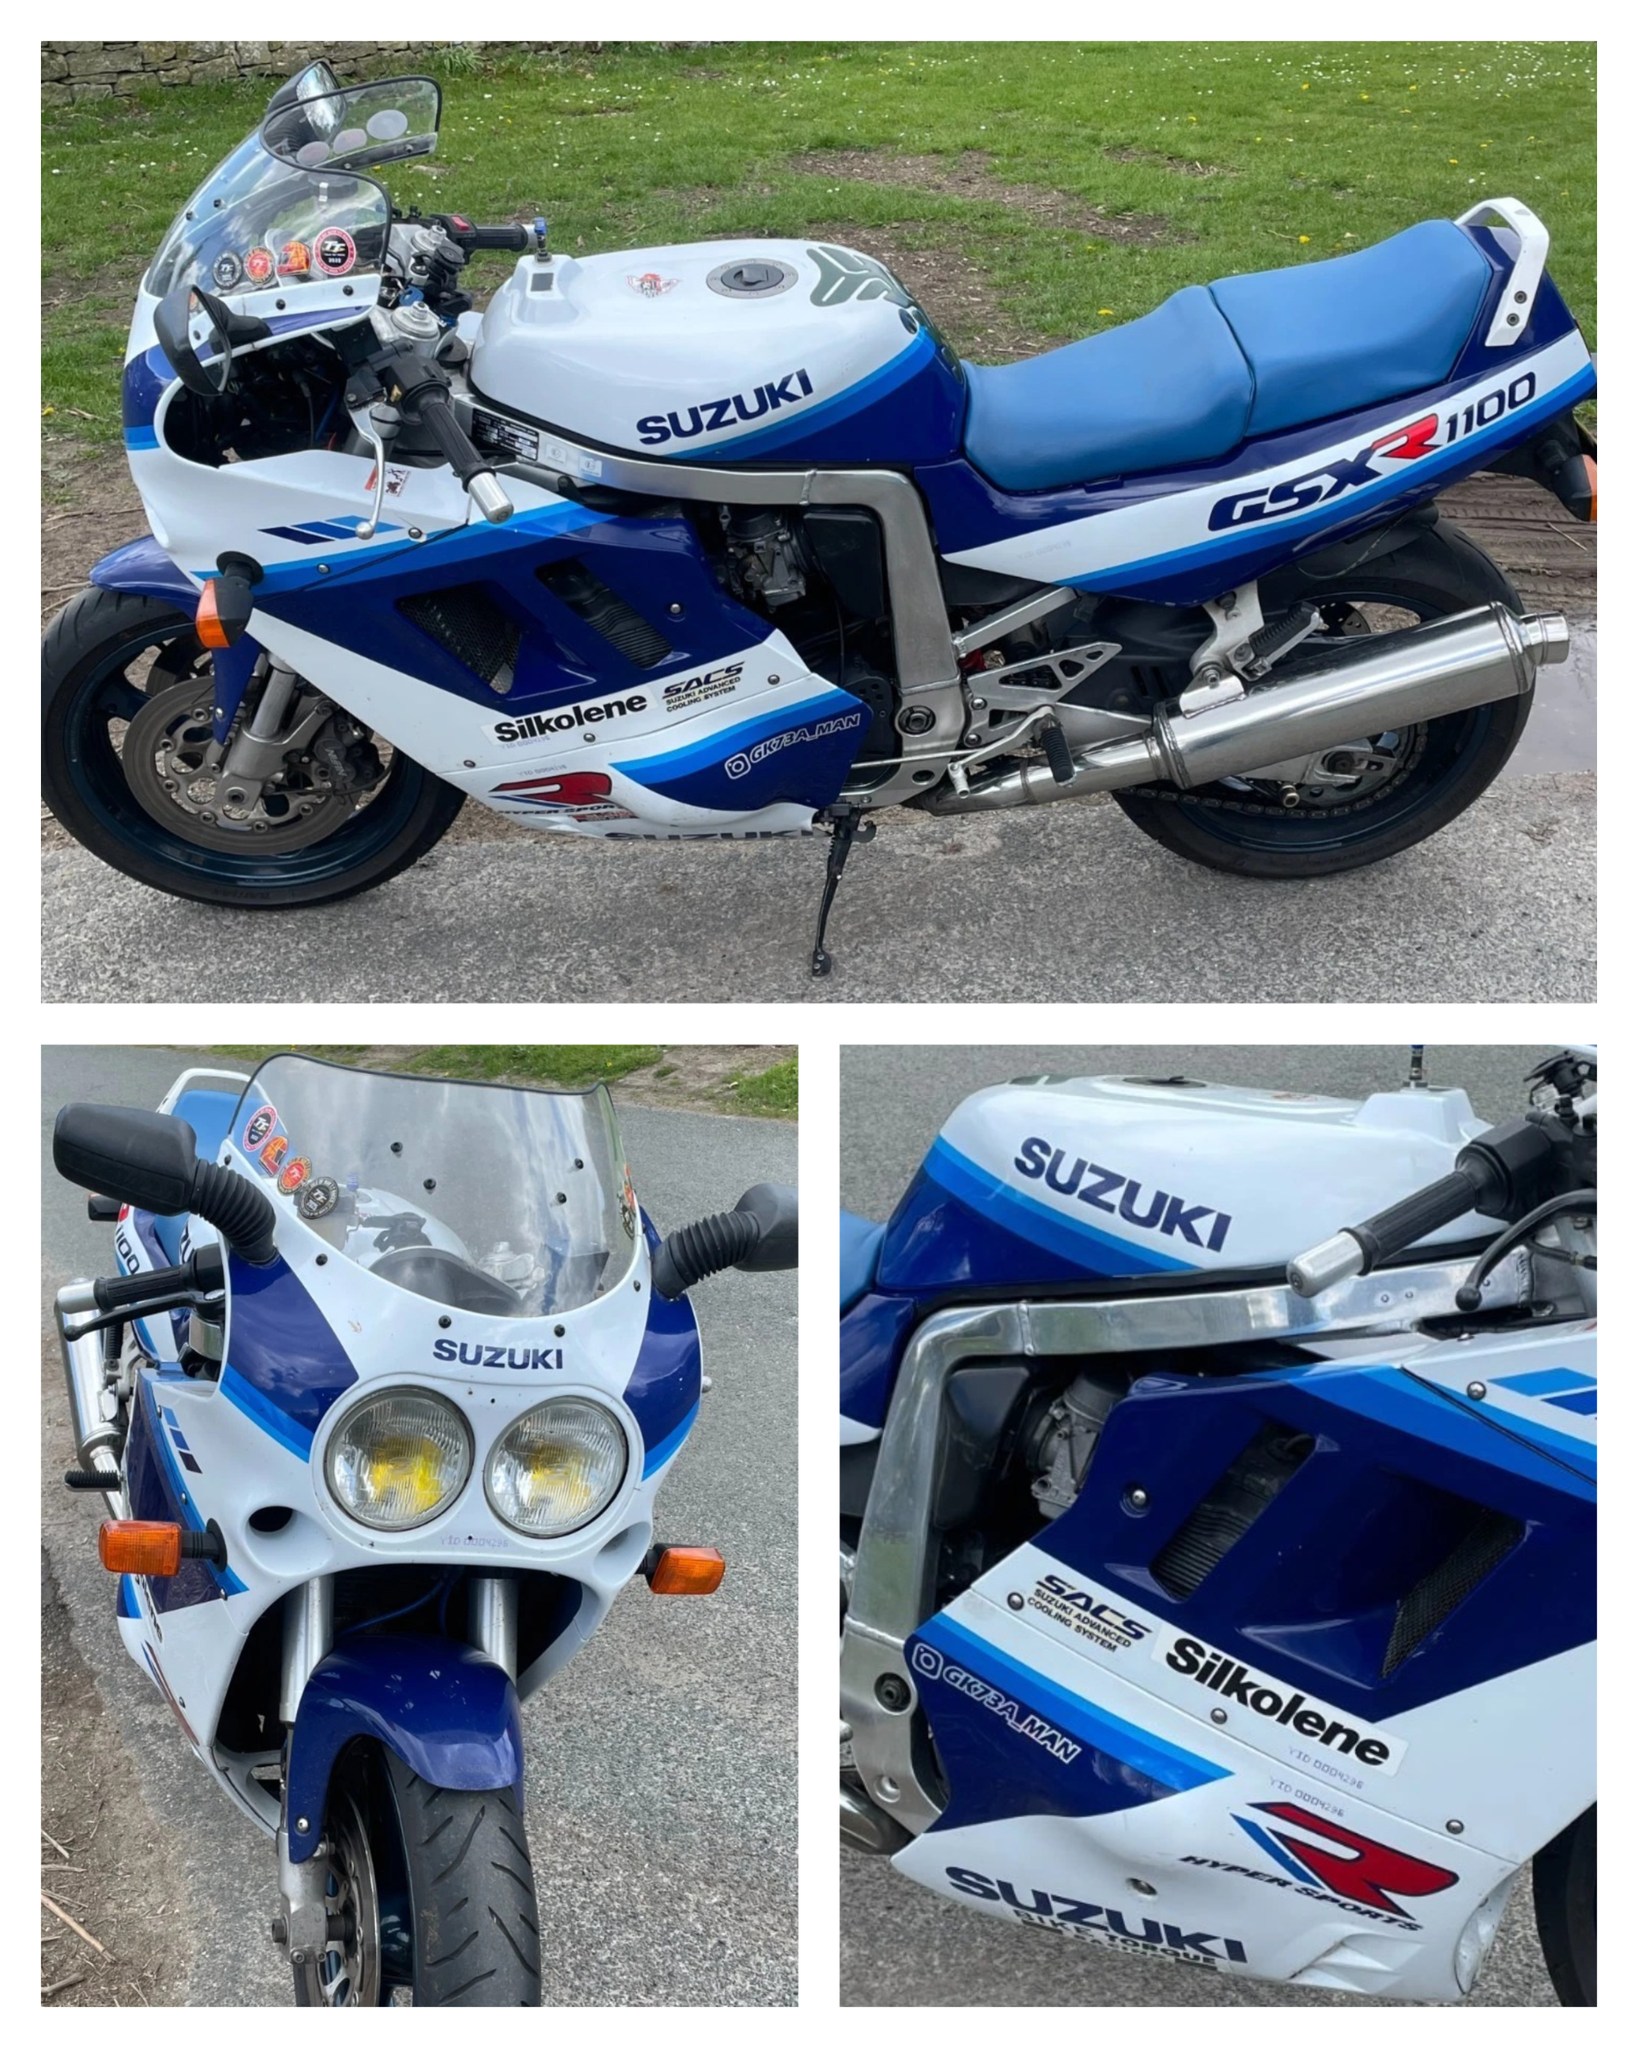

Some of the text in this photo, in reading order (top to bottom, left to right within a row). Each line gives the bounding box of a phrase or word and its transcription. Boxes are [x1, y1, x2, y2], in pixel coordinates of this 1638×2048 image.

[636, 368, 814, 445] SUZUKI
[1445, 371, 1536, 444] 1100
[662, 661, 745, 699] SACS
[666, 676, 742, 705] SUZUKI ADVANCED
[666, 685, 736, 712] COOLING SYSTEM
[494, 694, 648, 743] Silkolene
[750, 713, 861, 763] GK73A_MAN
[1014, 1137, 1232, 1253] SUZUKI
[115, 1225, 140, 1275] 1100
[432, 1338, 563, 1370] SUZUKI
[1027, 1597, 1118, 1653] COOLING SYSTEM
[1034, 1588, 1132, 1648] SUZUKI ADVANCED
[1036, 1574, 1153, 1641] SACS
[943, 1665, 1082, 1764] GK73A_MAN
[1166, 1637, 1390, 1766] Silkolene
[945, 1866, 1247, 1964] SUZUKI
[1178, 1855, 1424, 1932] HYPER SPORTS
[1105, 1933, 1215, 1964] TORQUE
